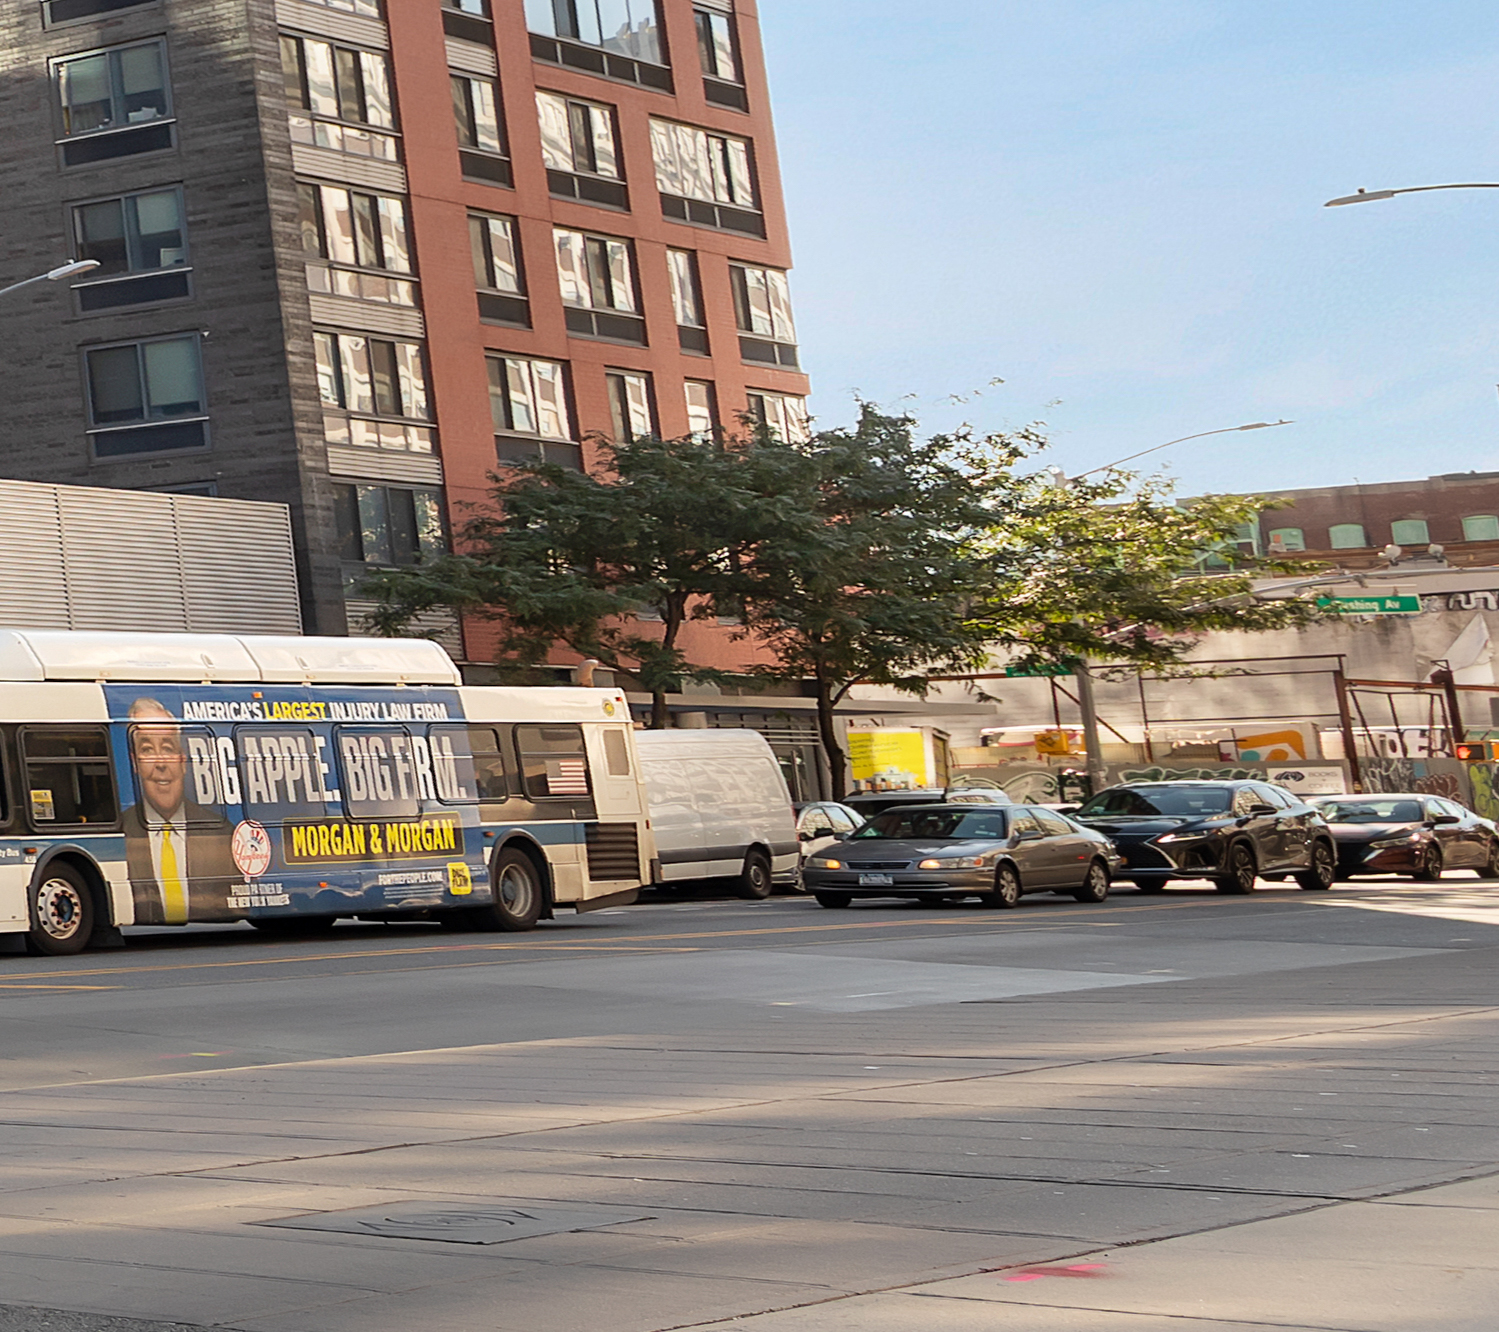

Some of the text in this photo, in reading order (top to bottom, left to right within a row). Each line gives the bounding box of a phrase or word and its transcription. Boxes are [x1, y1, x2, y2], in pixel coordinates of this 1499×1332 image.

[1385, 598, 1401, 609] Av
[183, 701, 448, 721] AMERICA'S LARGEST INJURY LAW FIRM
[188, 736, 467, 805] BIG APPLE. BIG FIRM.
[291, 819, 455, 857] MORGAN & MORGAN
